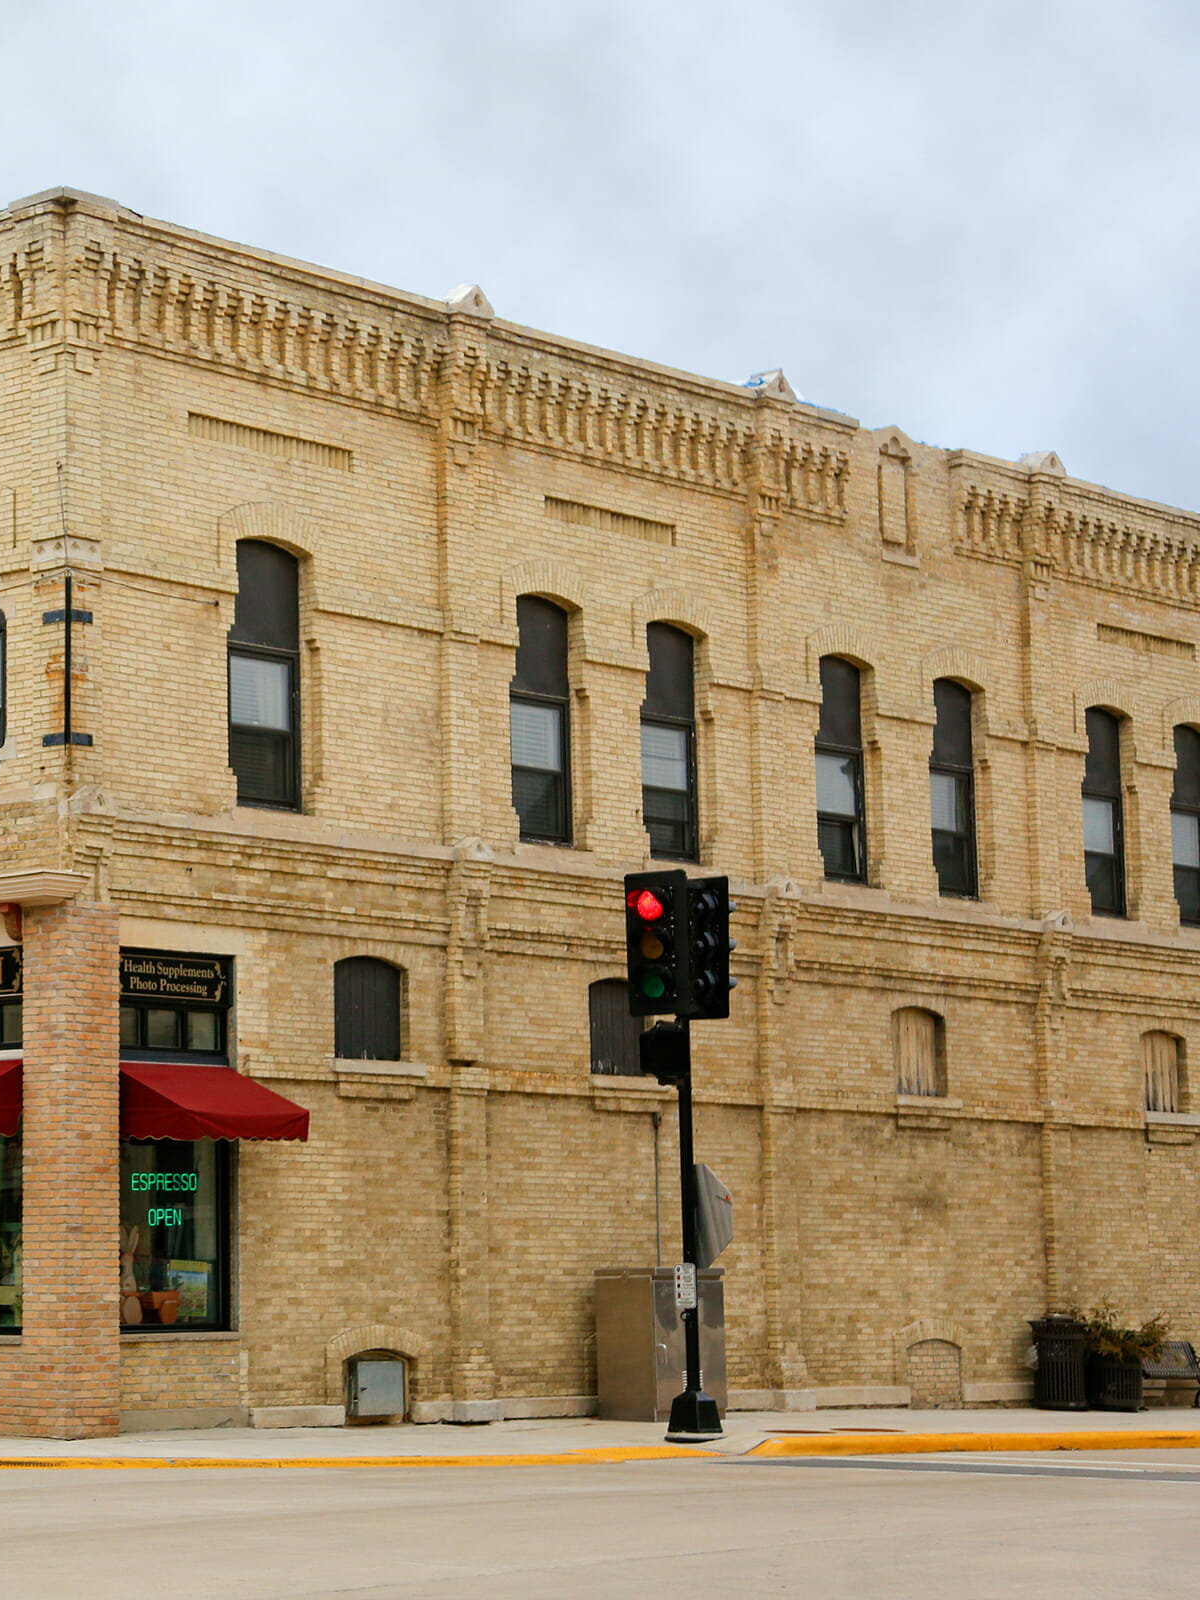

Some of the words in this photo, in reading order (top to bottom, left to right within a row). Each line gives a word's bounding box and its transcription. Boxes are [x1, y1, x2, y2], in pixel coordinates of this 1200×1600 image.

[124, 959, 156, 974] Health
[156, 961, 215, 979] Supplements
[129, 976, 158, 991] Photo
[160, 978, 208, 997] Processing
[131, 1172, 198, 1191] ESPRESSO
[147, 1208, 182, 1227] OPEN
